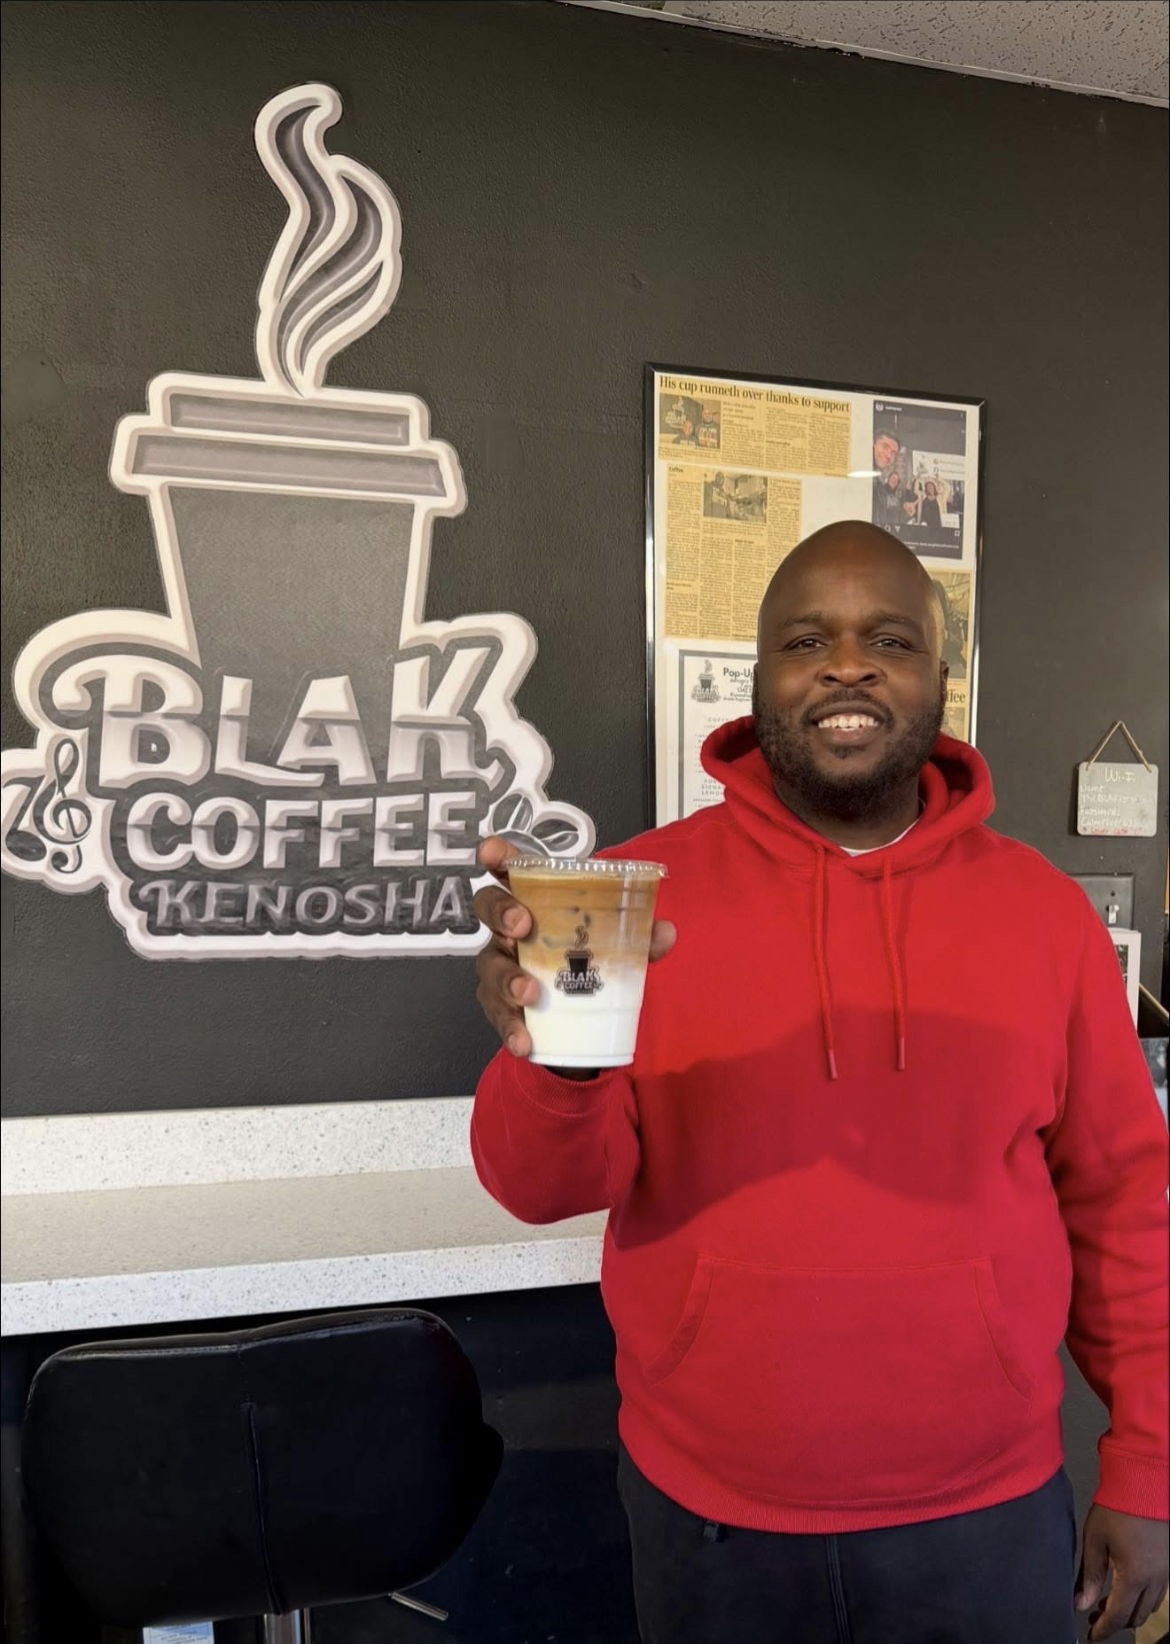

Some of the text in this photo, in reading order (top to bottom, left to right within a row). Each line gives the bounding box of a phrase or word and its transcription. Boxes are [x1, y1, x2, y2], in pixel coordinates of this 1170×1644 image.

[659, 375, 849, 413] His cup runneth over thanks to support
[52, 646, 506, 788] BLAK
[126, 791, 478, 871] COFFEE
[138, 876, 467, 929] KENOSHA
